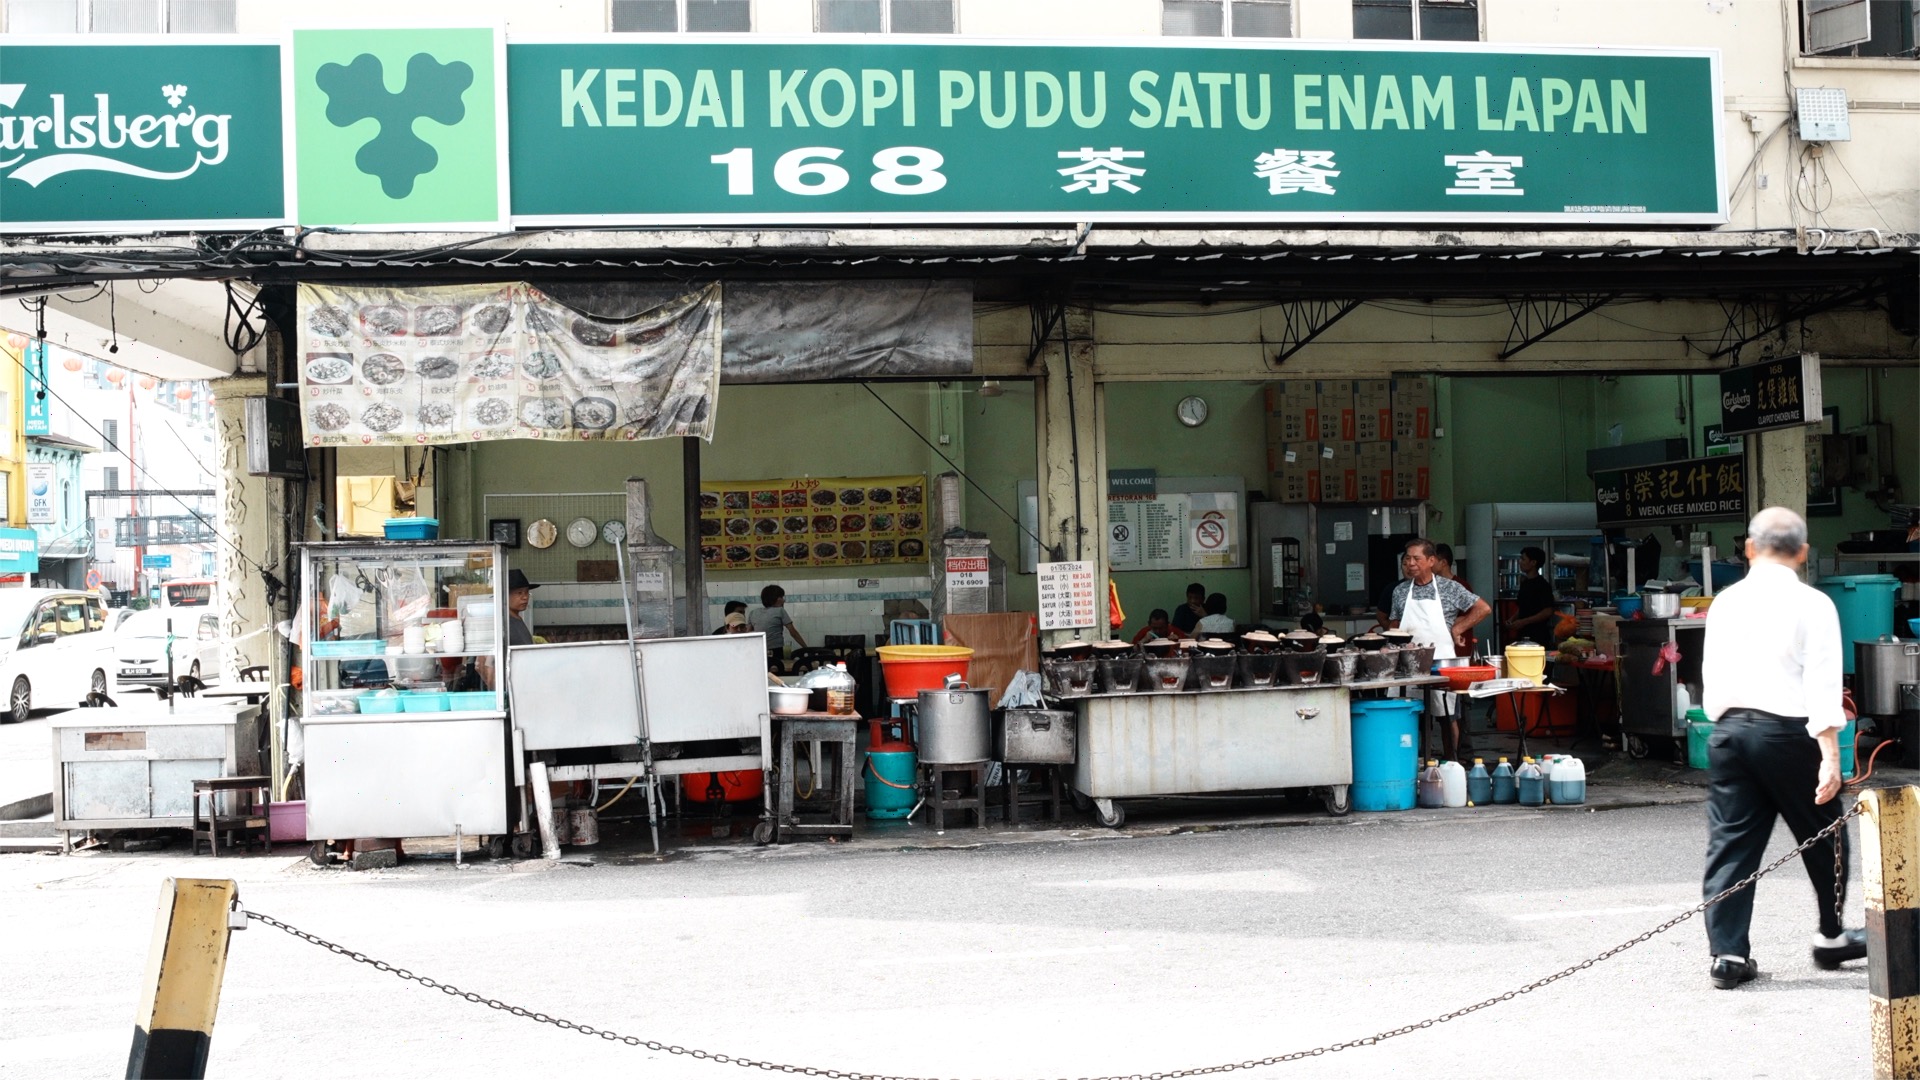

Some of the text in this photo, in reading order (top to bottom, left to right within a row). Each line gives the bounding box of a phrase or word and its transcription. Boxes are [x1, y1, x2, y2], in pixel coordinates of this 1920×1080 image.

[560, 67, 1648, 134] KEDAI KOPI PUDU SATU ENAM LAPAN
[710, 146, 948, 196] 168
[1769, 364, 1783, 375] 168
[1723, 390, 1751, 412] Carlsberg
[1758, 410, 1800, 425] CLAYPOT CHICKEN RICE
[790, 480, 820, 489] 小炒
[1111, 477, 1153, 486] WELCOME
[1633, 462, 1744, 503] 榮記什飯
[34, 498, 47, 507] GFK
[1638, 499, 1742, 517] WENG KEE MIXED RICE
[948, 560, 986, 571] 档位出租
